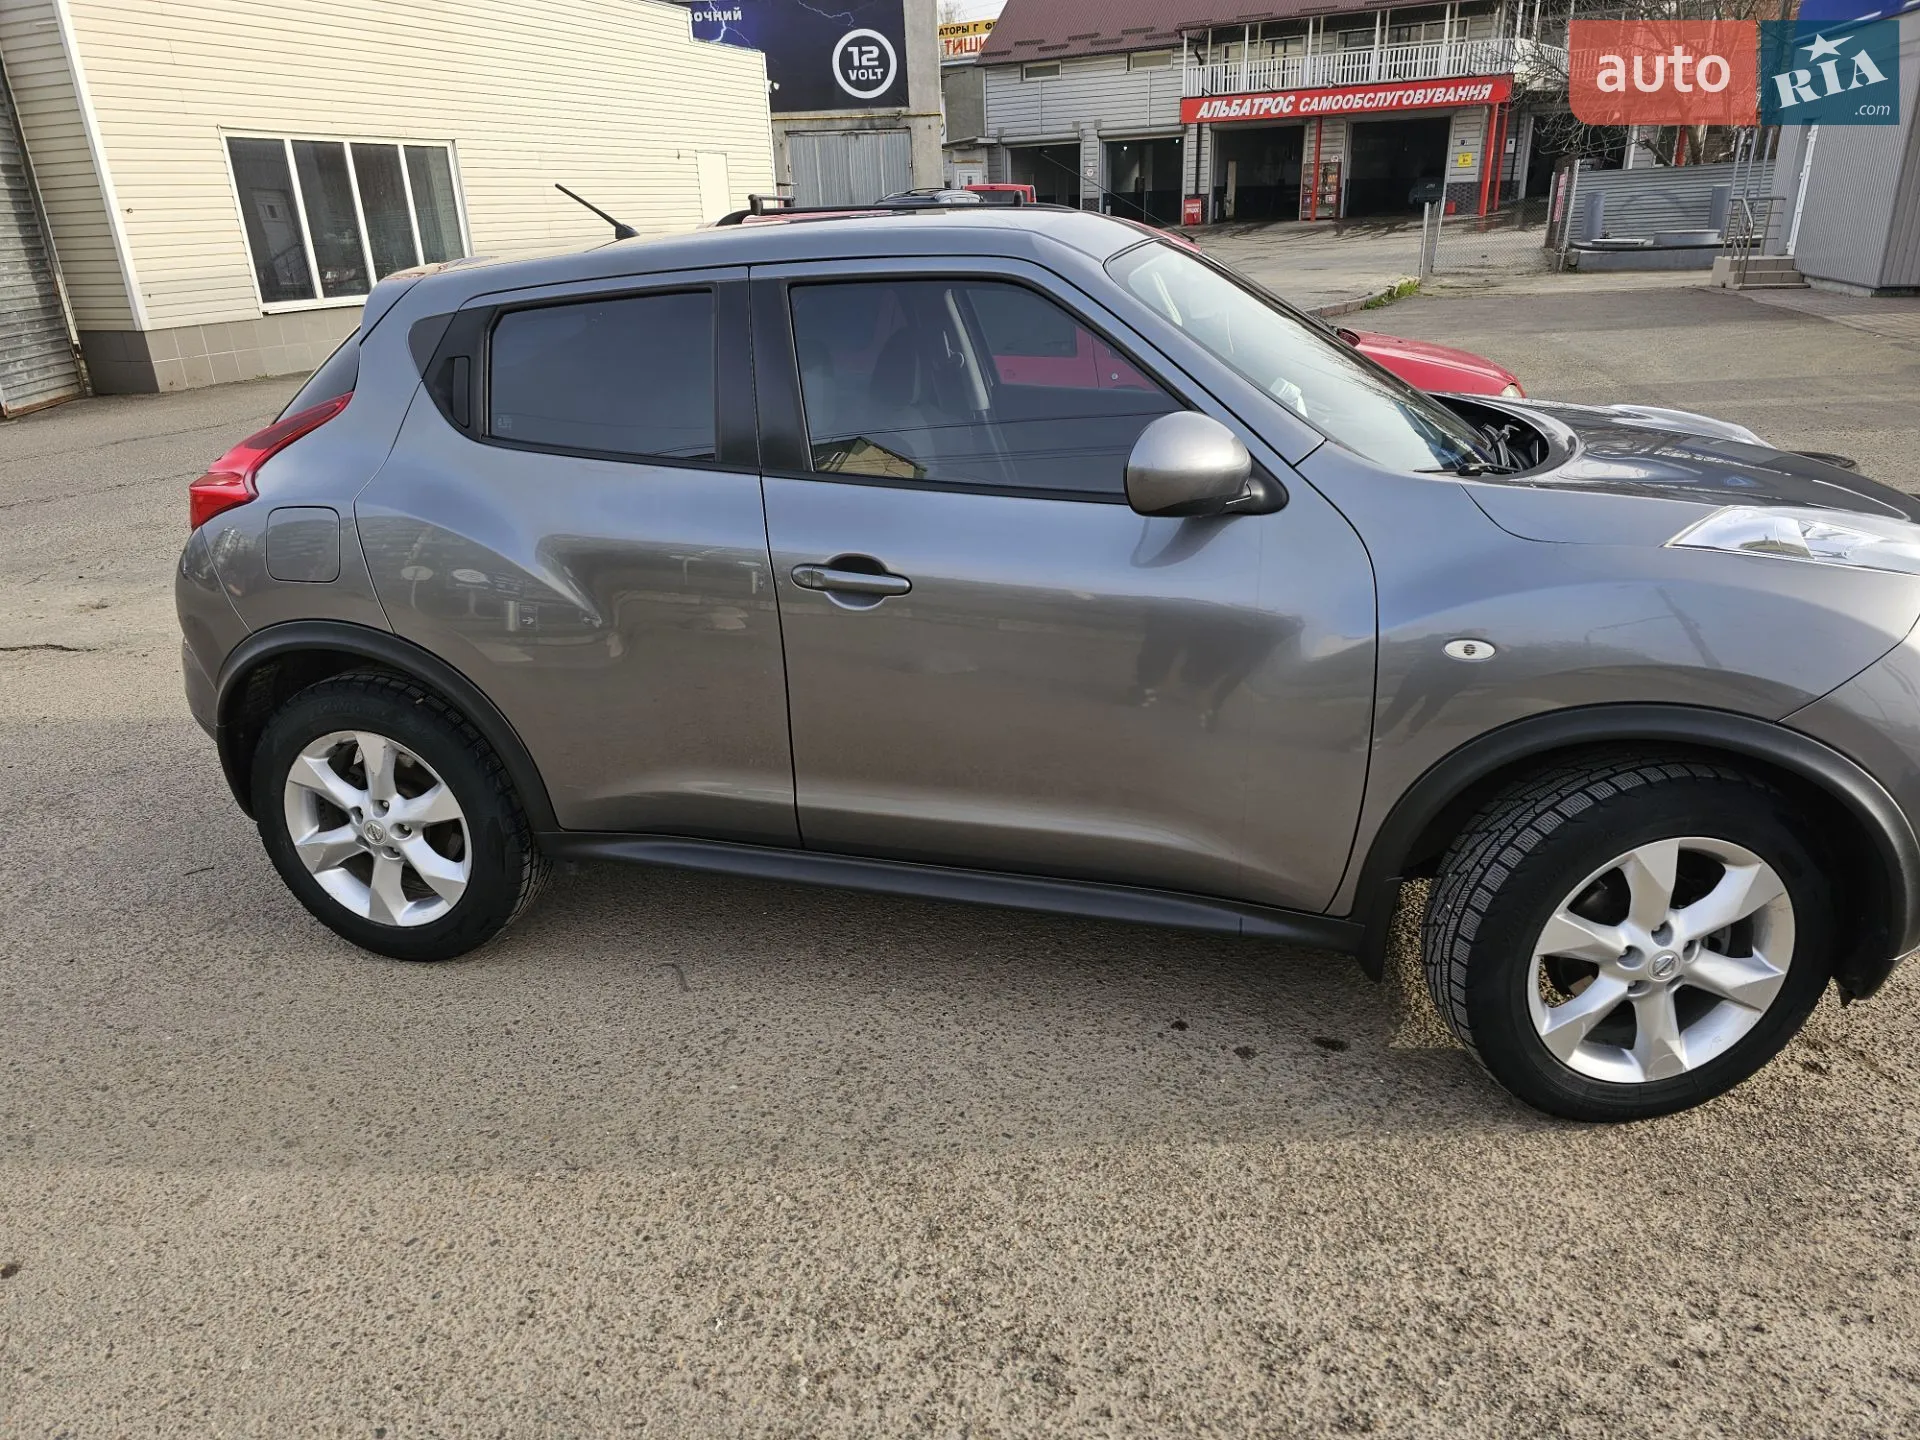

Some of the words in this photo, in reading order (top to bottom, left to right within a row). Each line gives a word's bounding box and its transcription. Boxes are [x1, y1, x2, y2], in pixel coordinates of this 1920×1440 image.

[848, 46, 878, 66] 12
[848, 68, 884, 81] VOLT
[1195, 95, 1295, 118] АЛЬБАТРОС
[1300, 84, 1492, 110] САМООБСЛУГОВУВАННЯ
